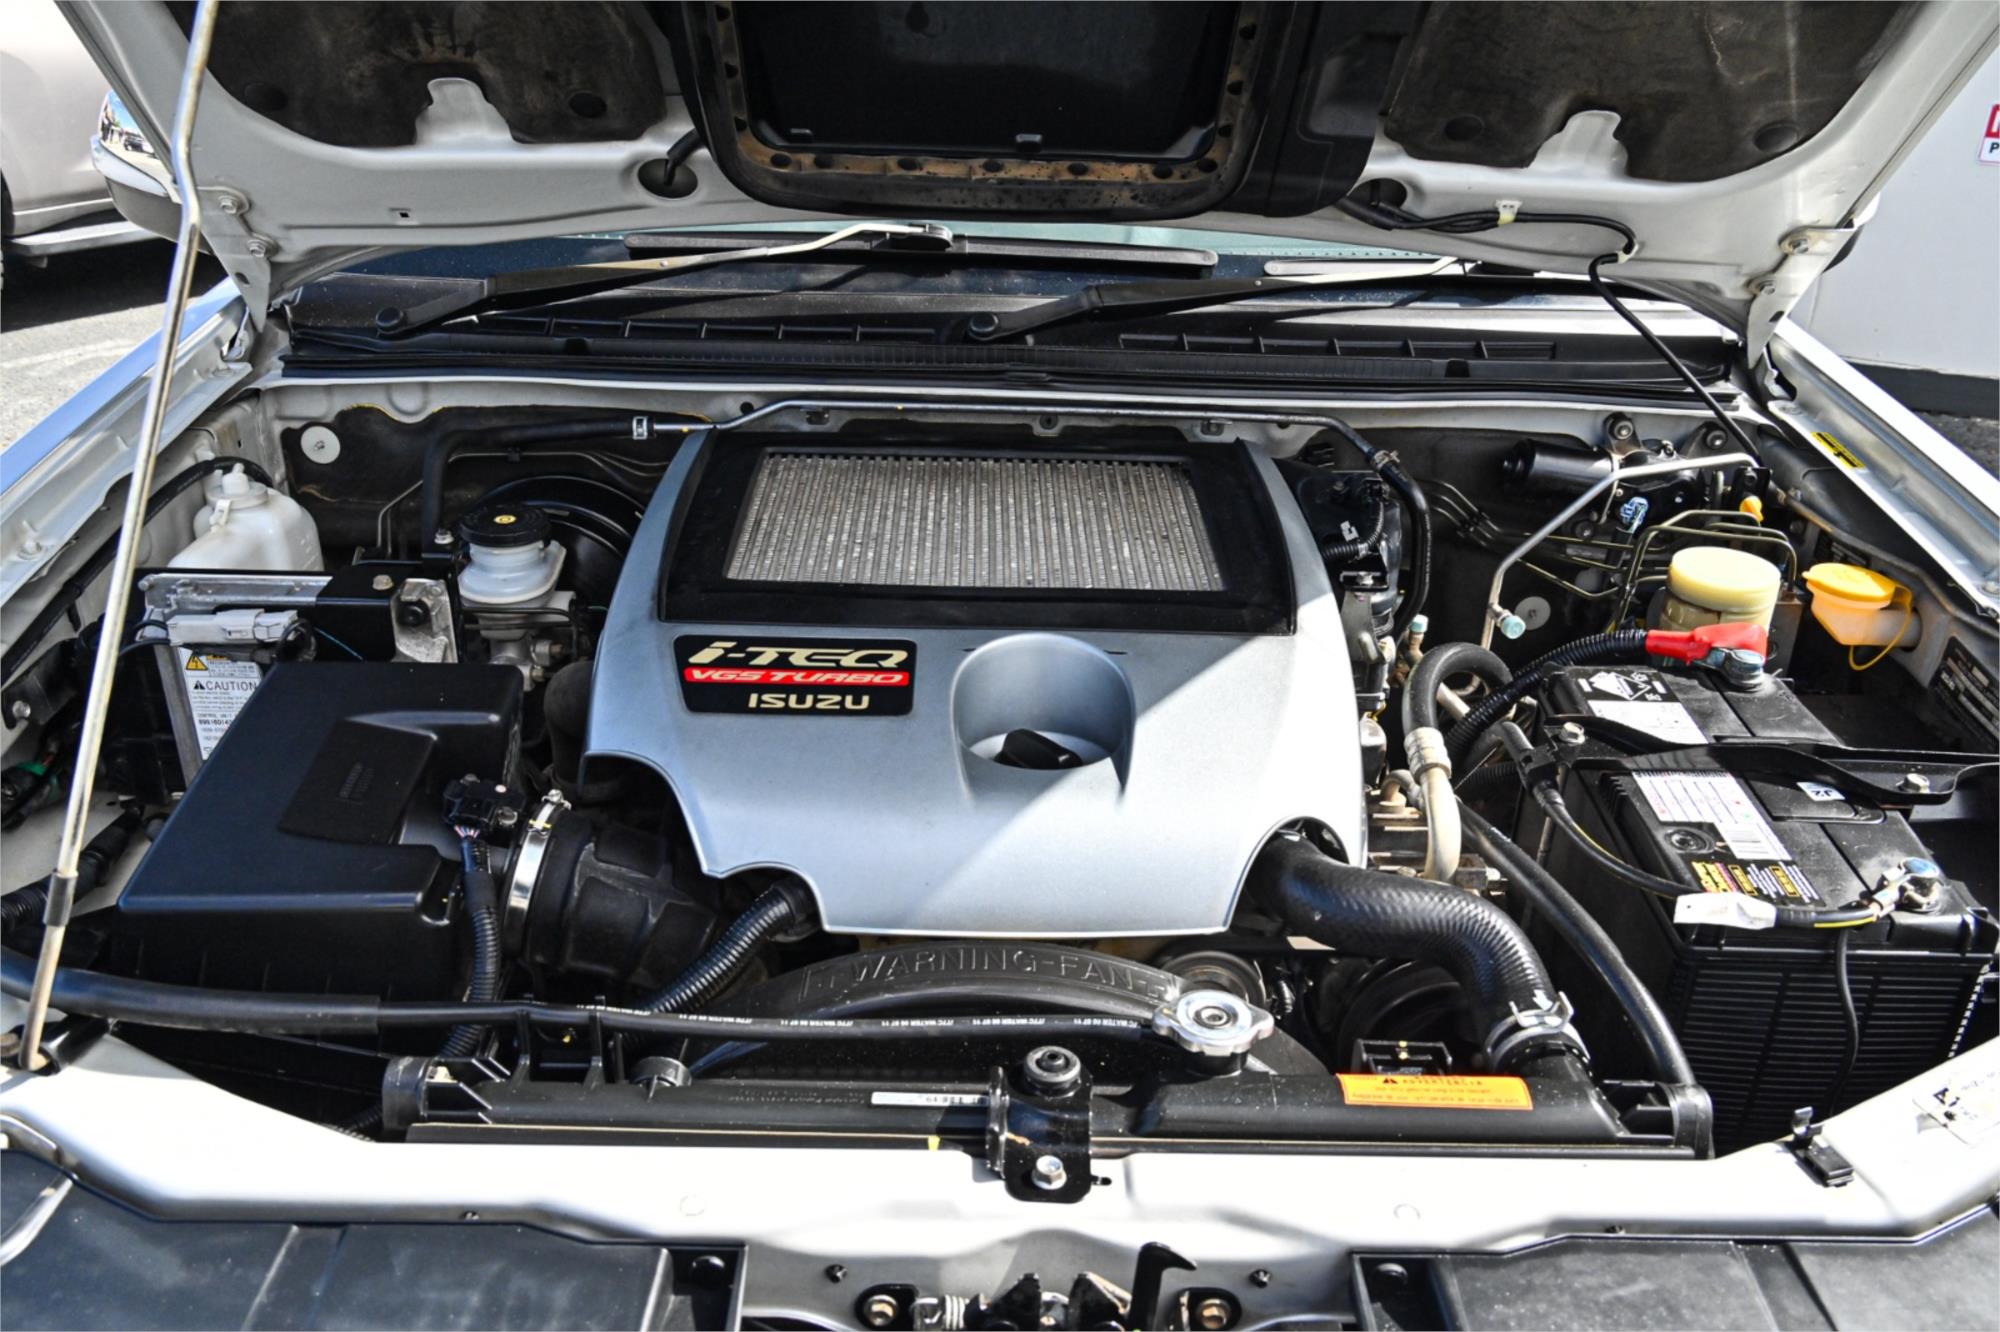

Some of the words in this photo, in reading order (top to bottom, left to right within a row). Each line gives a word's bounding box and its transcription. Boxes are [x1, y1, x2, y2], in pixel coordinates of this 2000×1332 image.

[692, 669, 761, 681] VGS
[768, 670, 903, 684] TURBO
[205, 681, 257, 691] CAUTION
[748, 693, 869, 709] ISUZU
